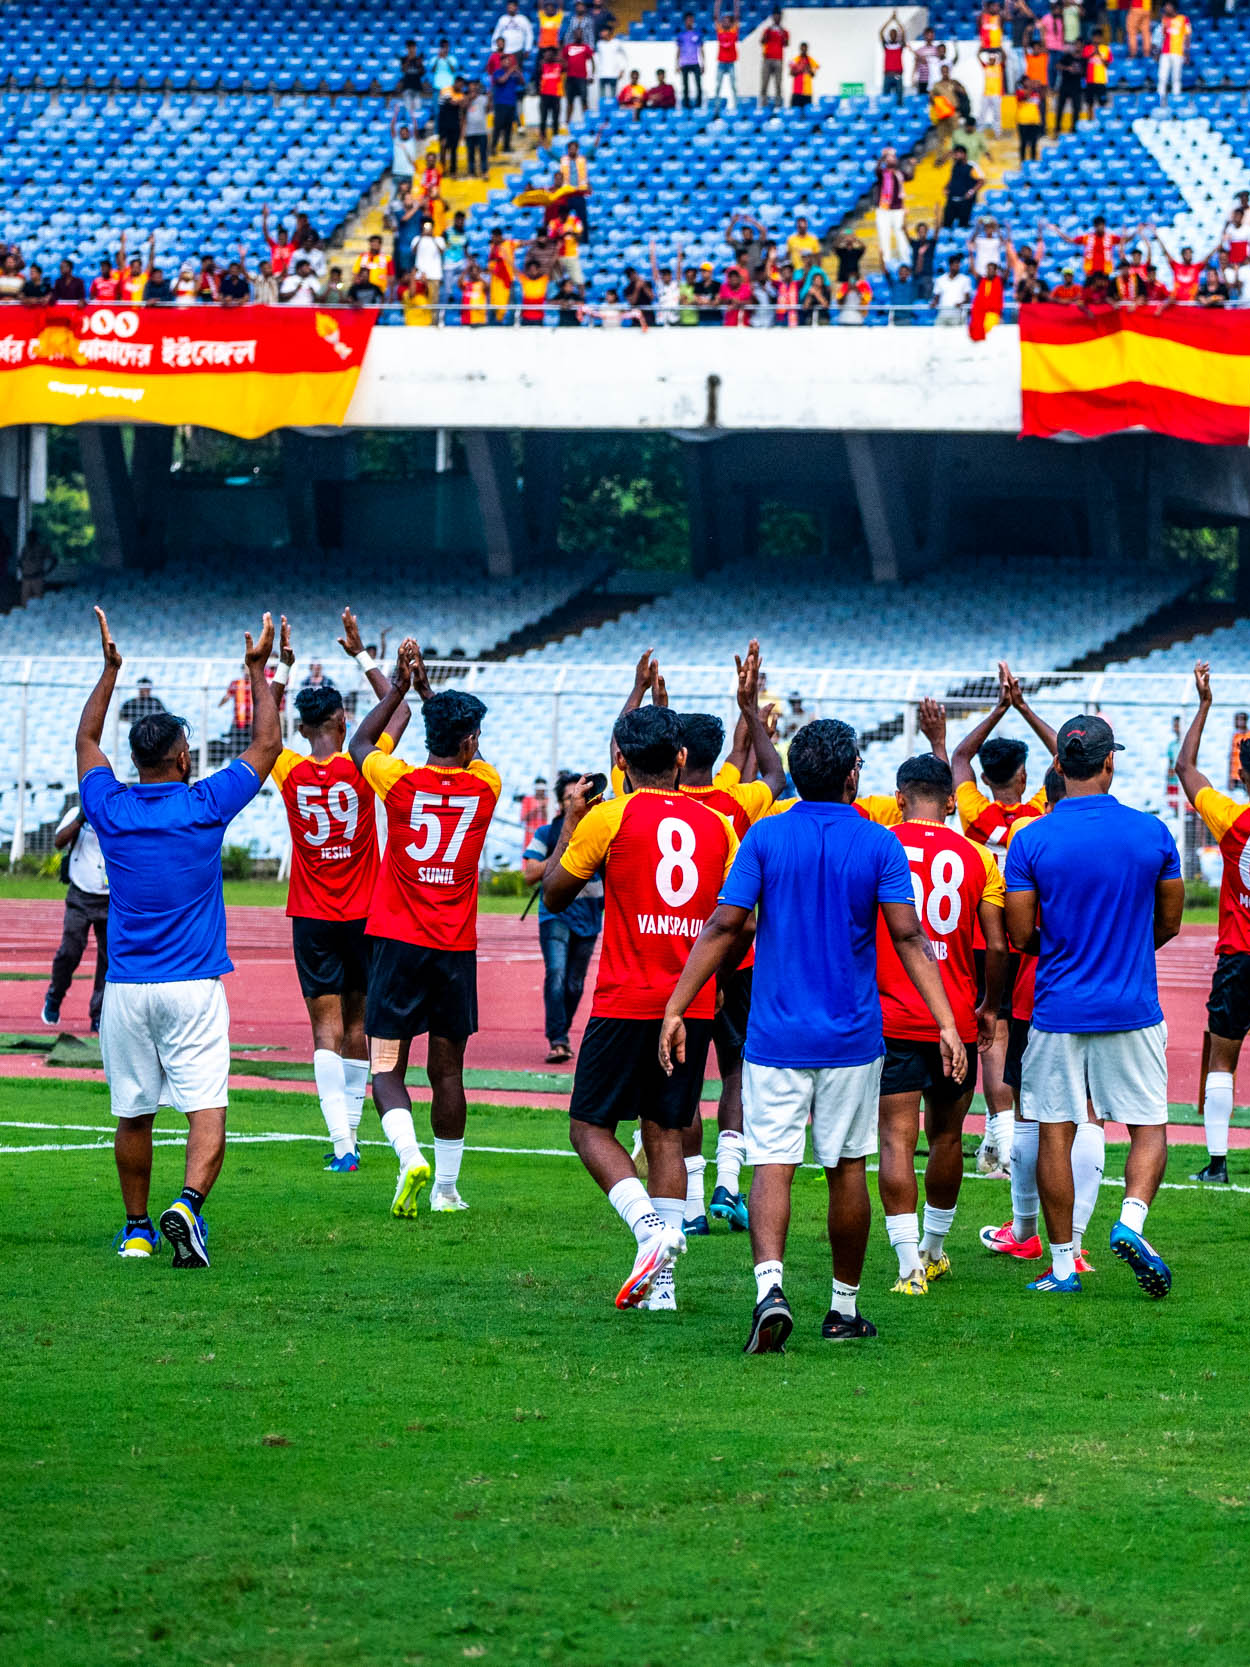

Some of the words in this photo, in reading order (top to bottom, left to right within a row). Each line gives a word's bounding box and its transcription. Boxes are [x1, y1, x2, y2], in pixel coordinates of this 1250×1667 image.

[296, 781, 359, 846] 59
[405, 790, 480, 863] 57
[418, 866, 455, 885] SUNIL
[656, 817, 699, 907] 8
[903, 846, 964, 935] 58
